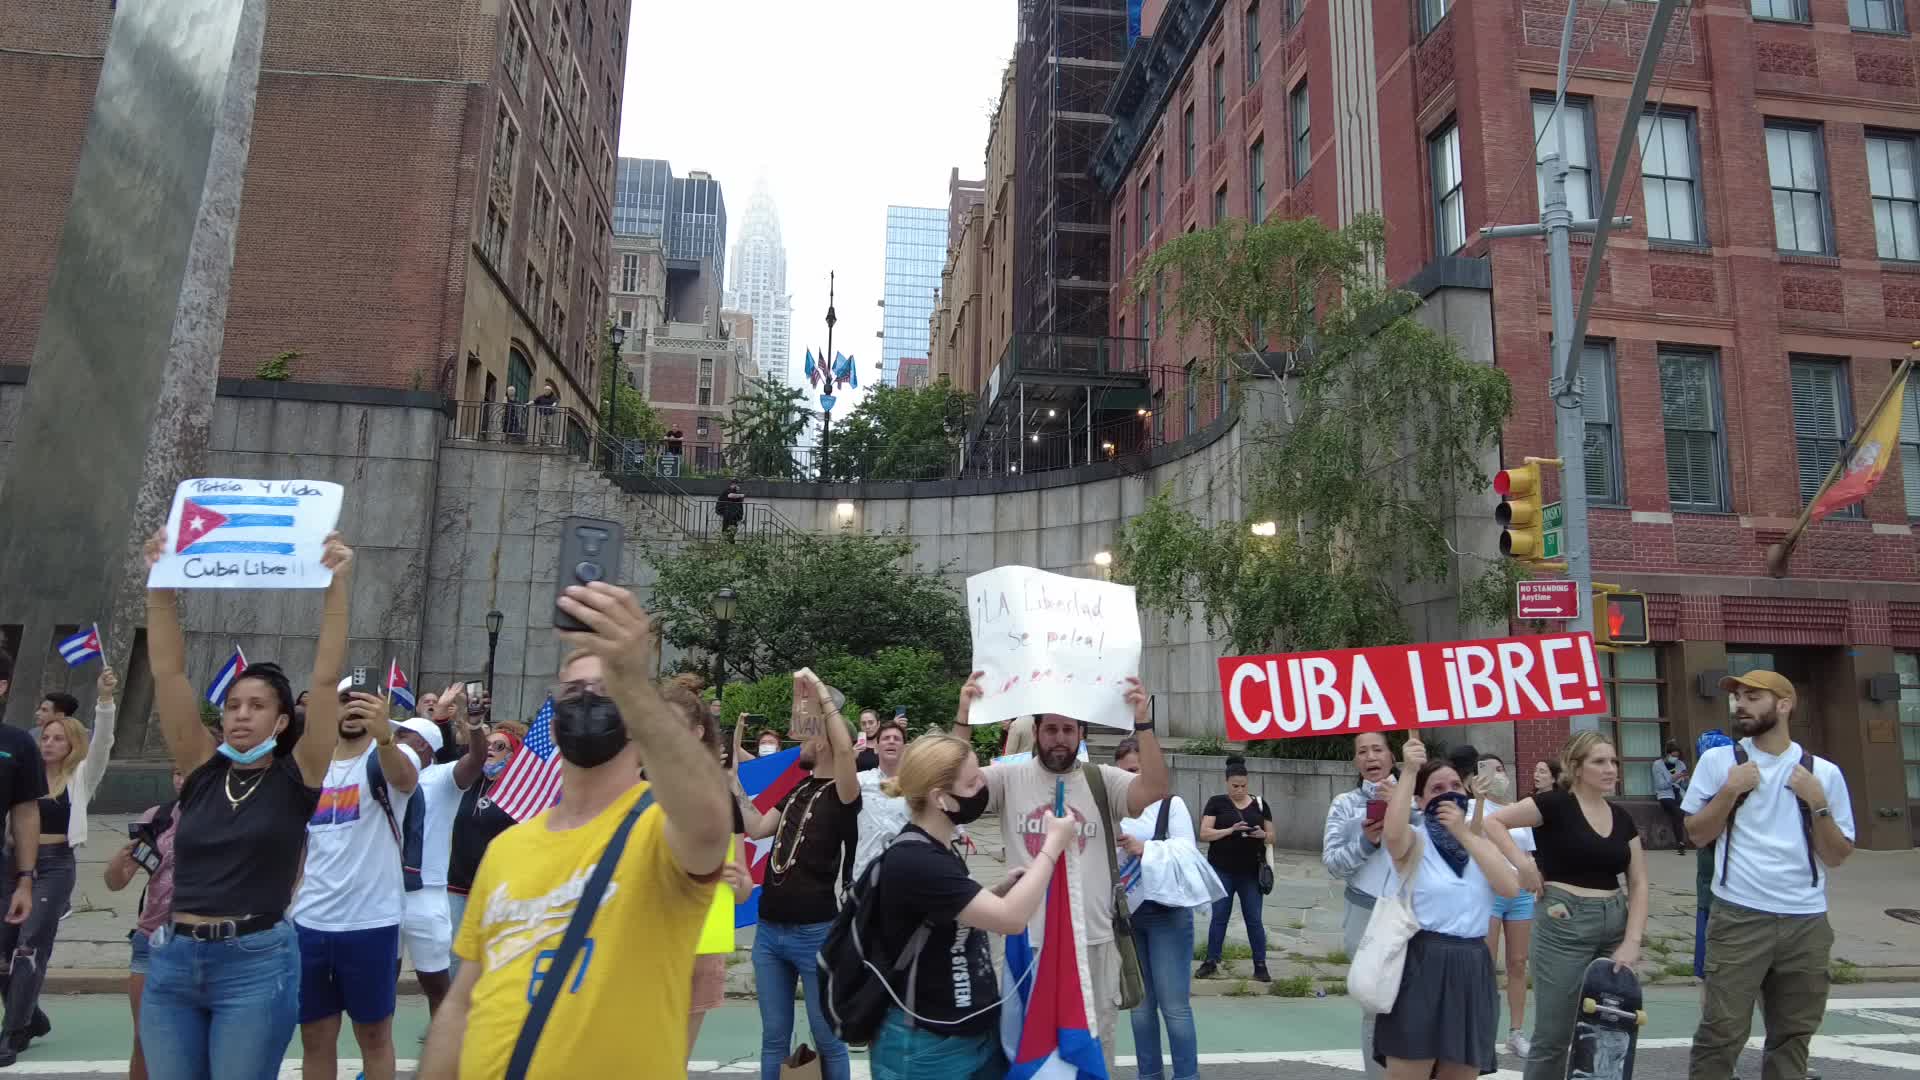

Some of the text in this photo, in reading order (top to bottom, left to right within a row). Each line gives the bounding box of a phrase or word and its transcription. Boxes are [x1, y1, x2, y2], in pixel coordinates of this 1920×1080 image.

[281, 481, 323, 497] Vida
[183, 557, 241, 578] Cuba
[1520, 585, 1569, 593] NO STANDING
[1520, 594, 1552, 603] Anytime
[1229, 654, 1397, 735] CUBA
[951, 955, 972, 1008] SYSTEM
